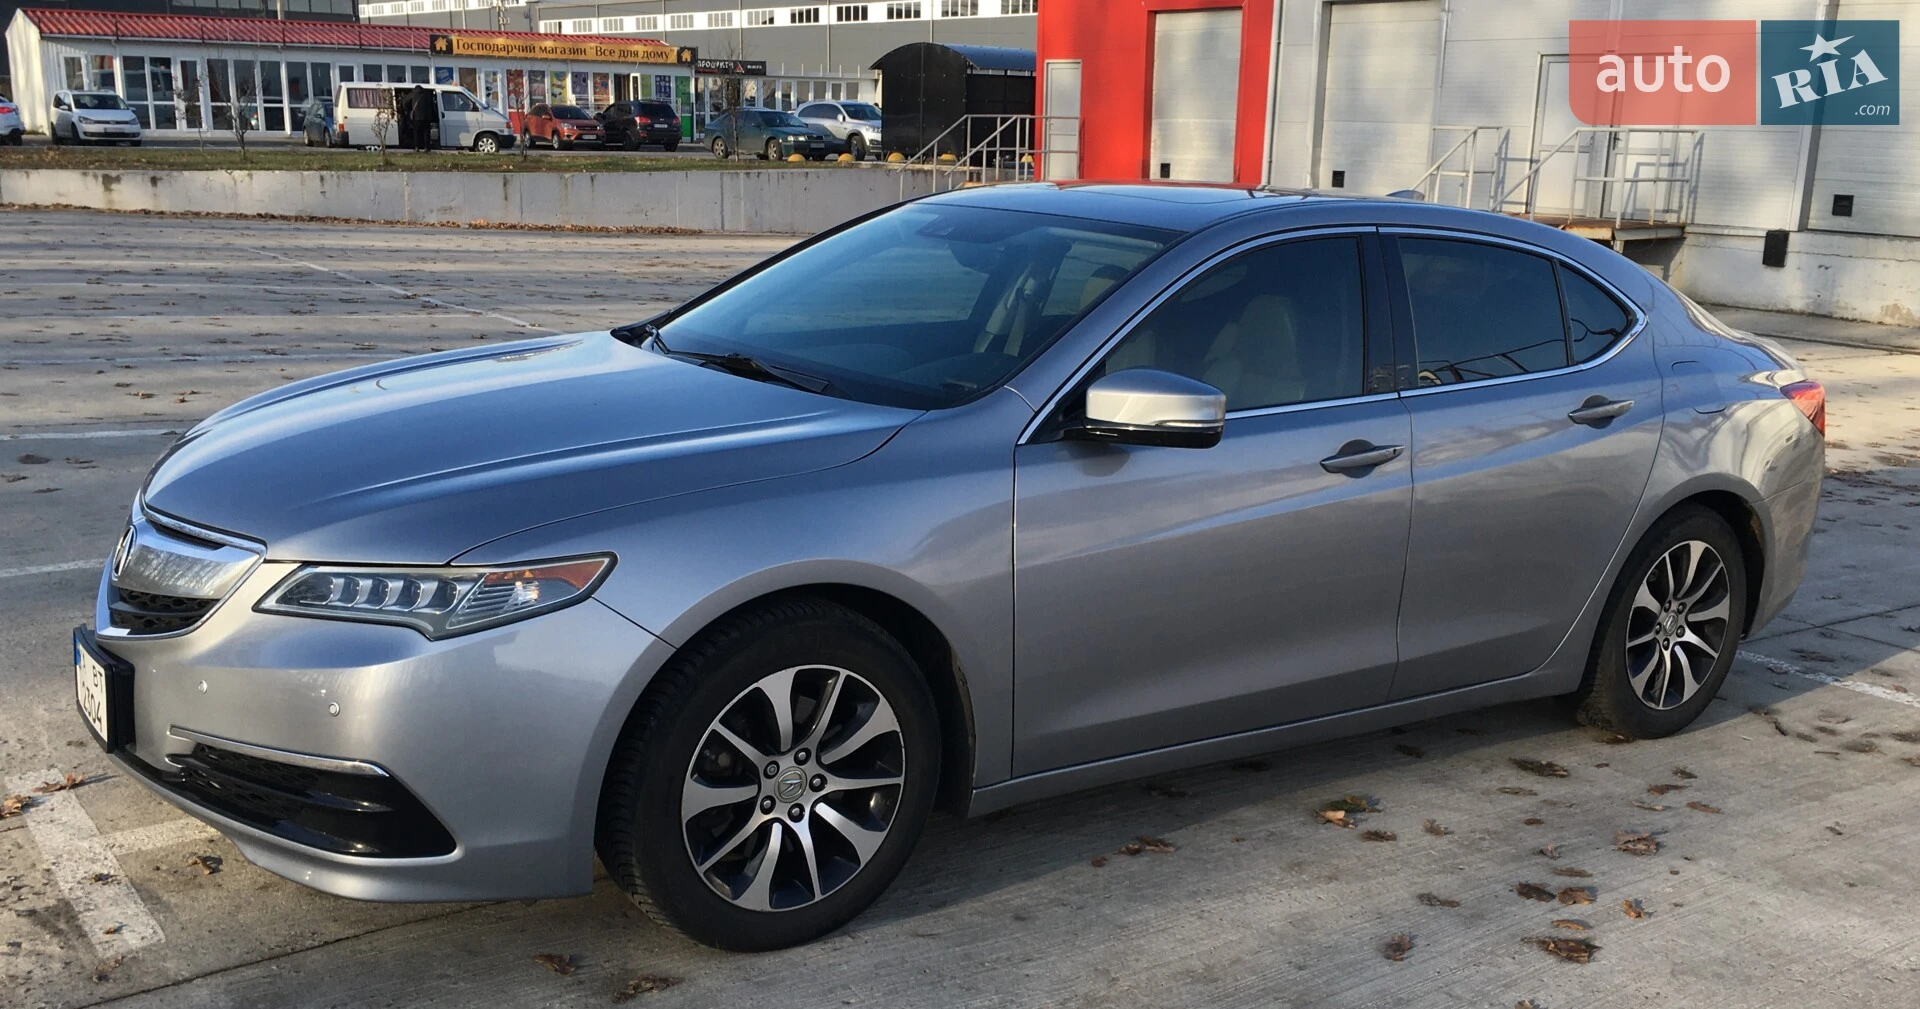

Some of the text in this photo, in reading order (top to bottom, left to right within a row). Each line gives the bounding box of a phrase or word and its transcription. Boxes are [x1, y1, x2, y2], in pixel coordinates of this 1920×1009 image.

[456, 38, 536, 55] Господарчий
[540, 45, 587, 56] магазин
[618, 49, 639, 59] для
